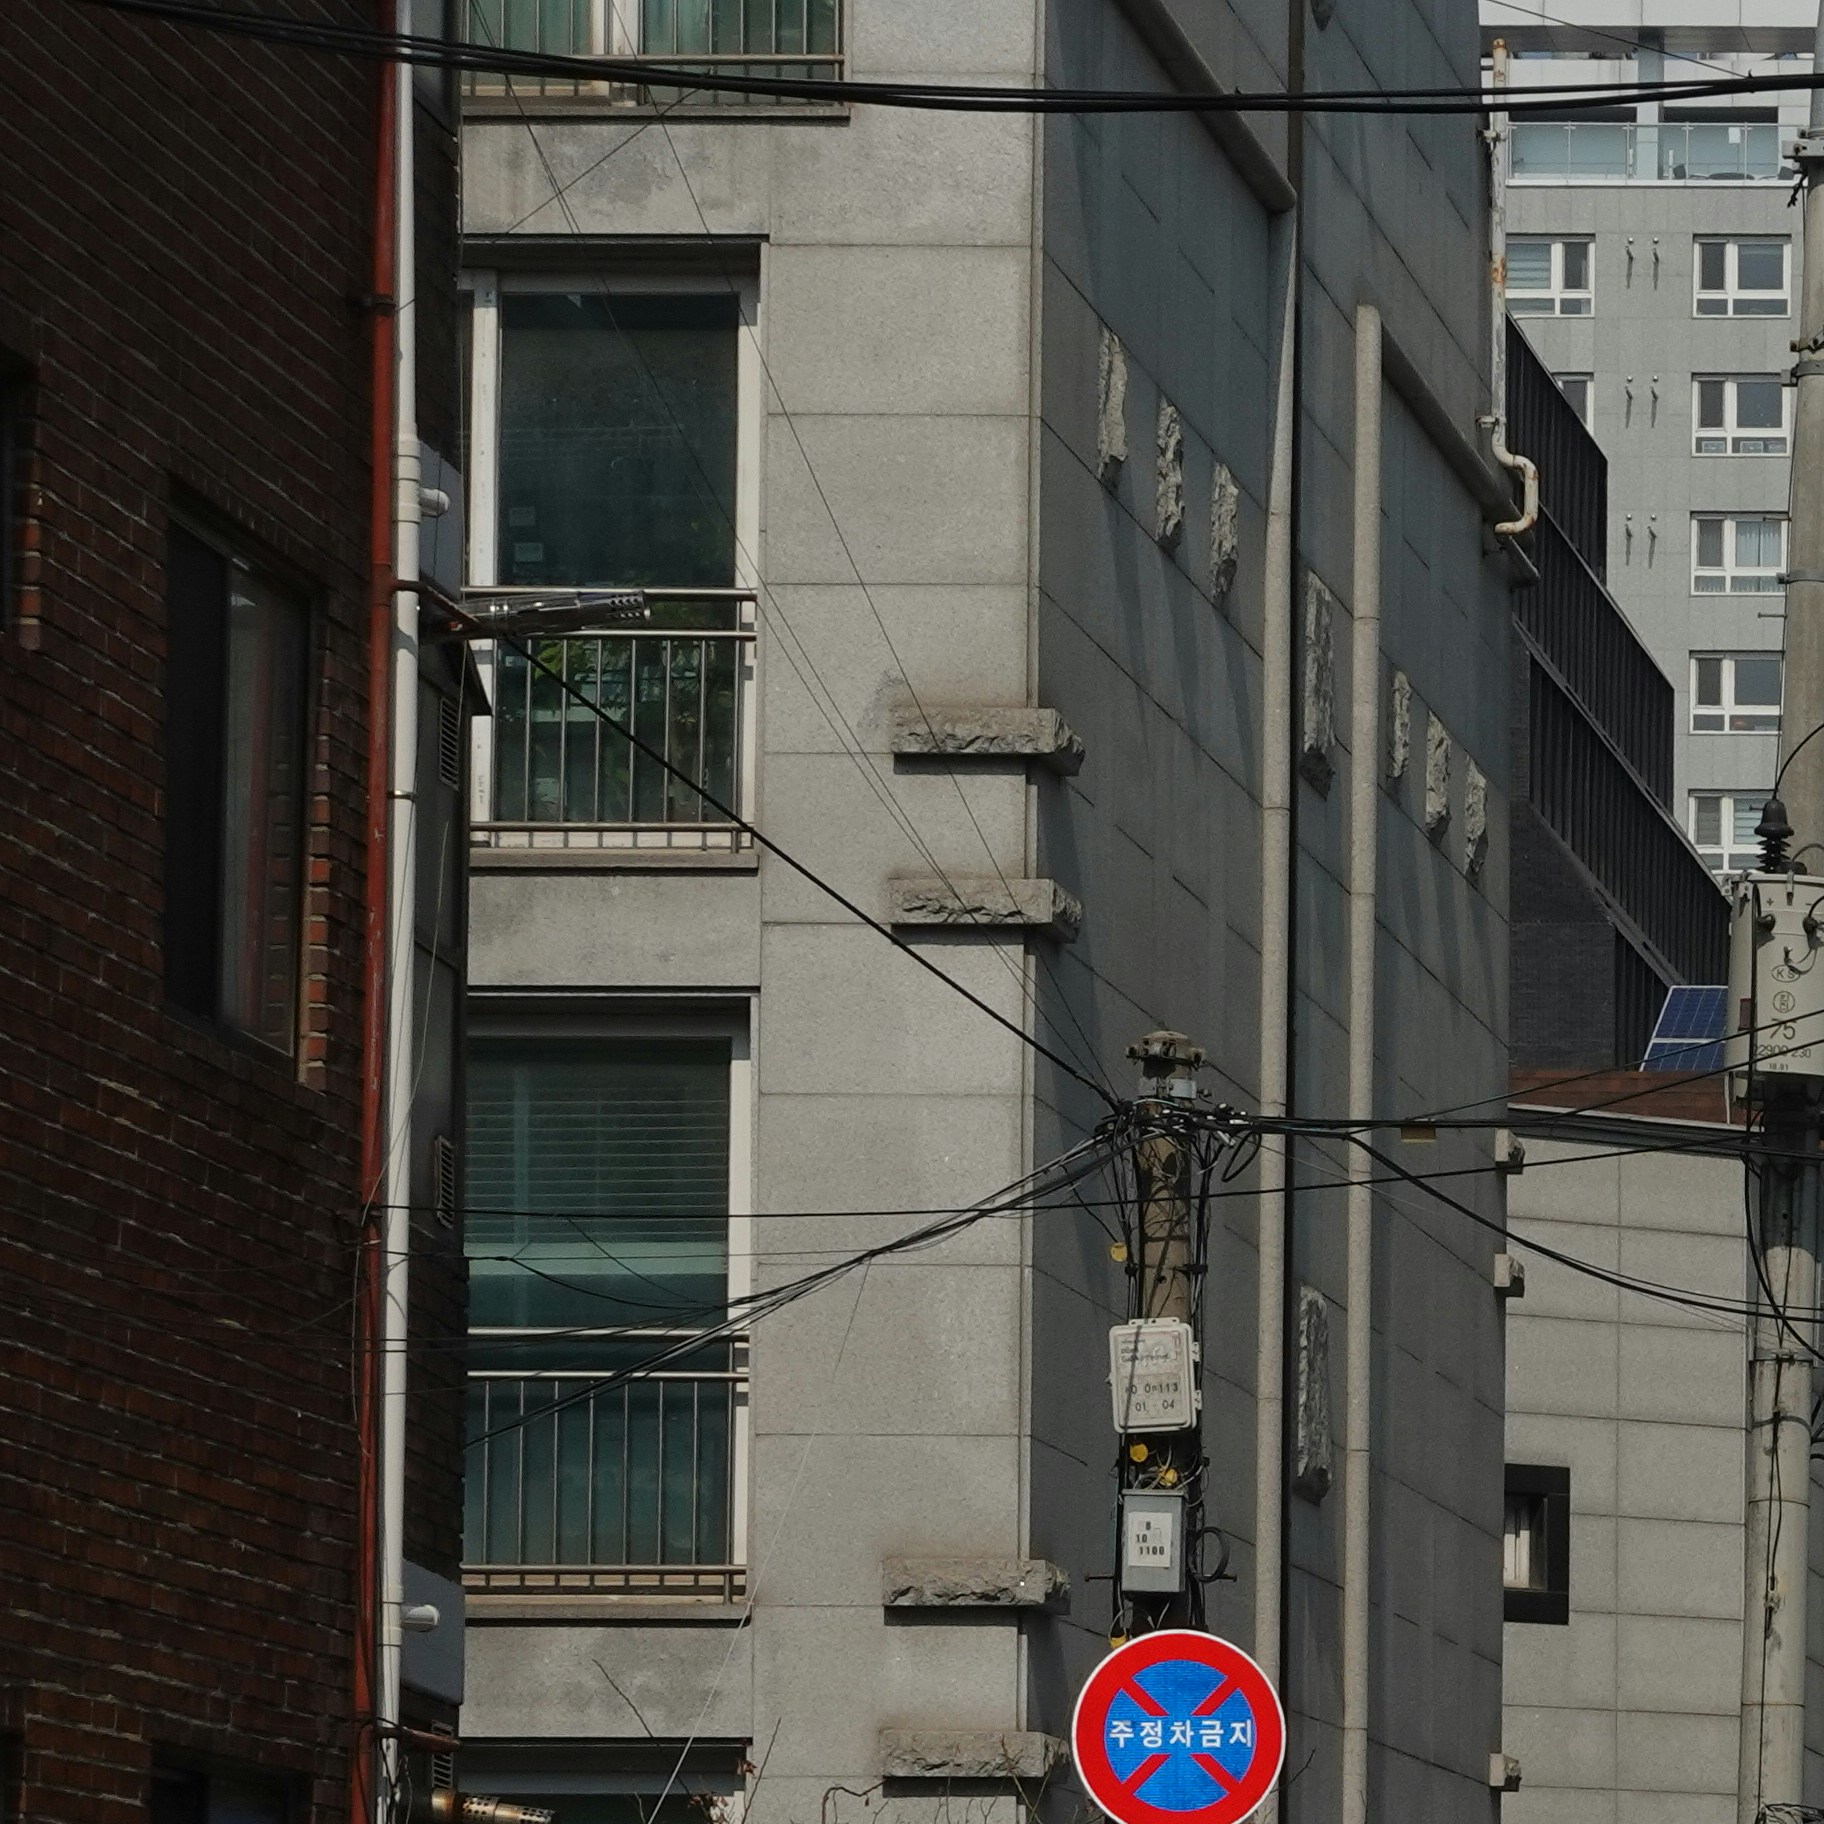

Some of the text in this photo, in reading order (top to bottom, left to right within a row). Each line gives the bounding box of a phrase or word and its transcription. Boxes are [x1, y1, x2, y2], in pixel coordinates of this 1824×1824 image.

[1756, 1044, 1812, 1059] 2900230
[1139, 1545, 1165, 1556] 1100
[1108, 1719, 1253, 1749] 주정차금지
